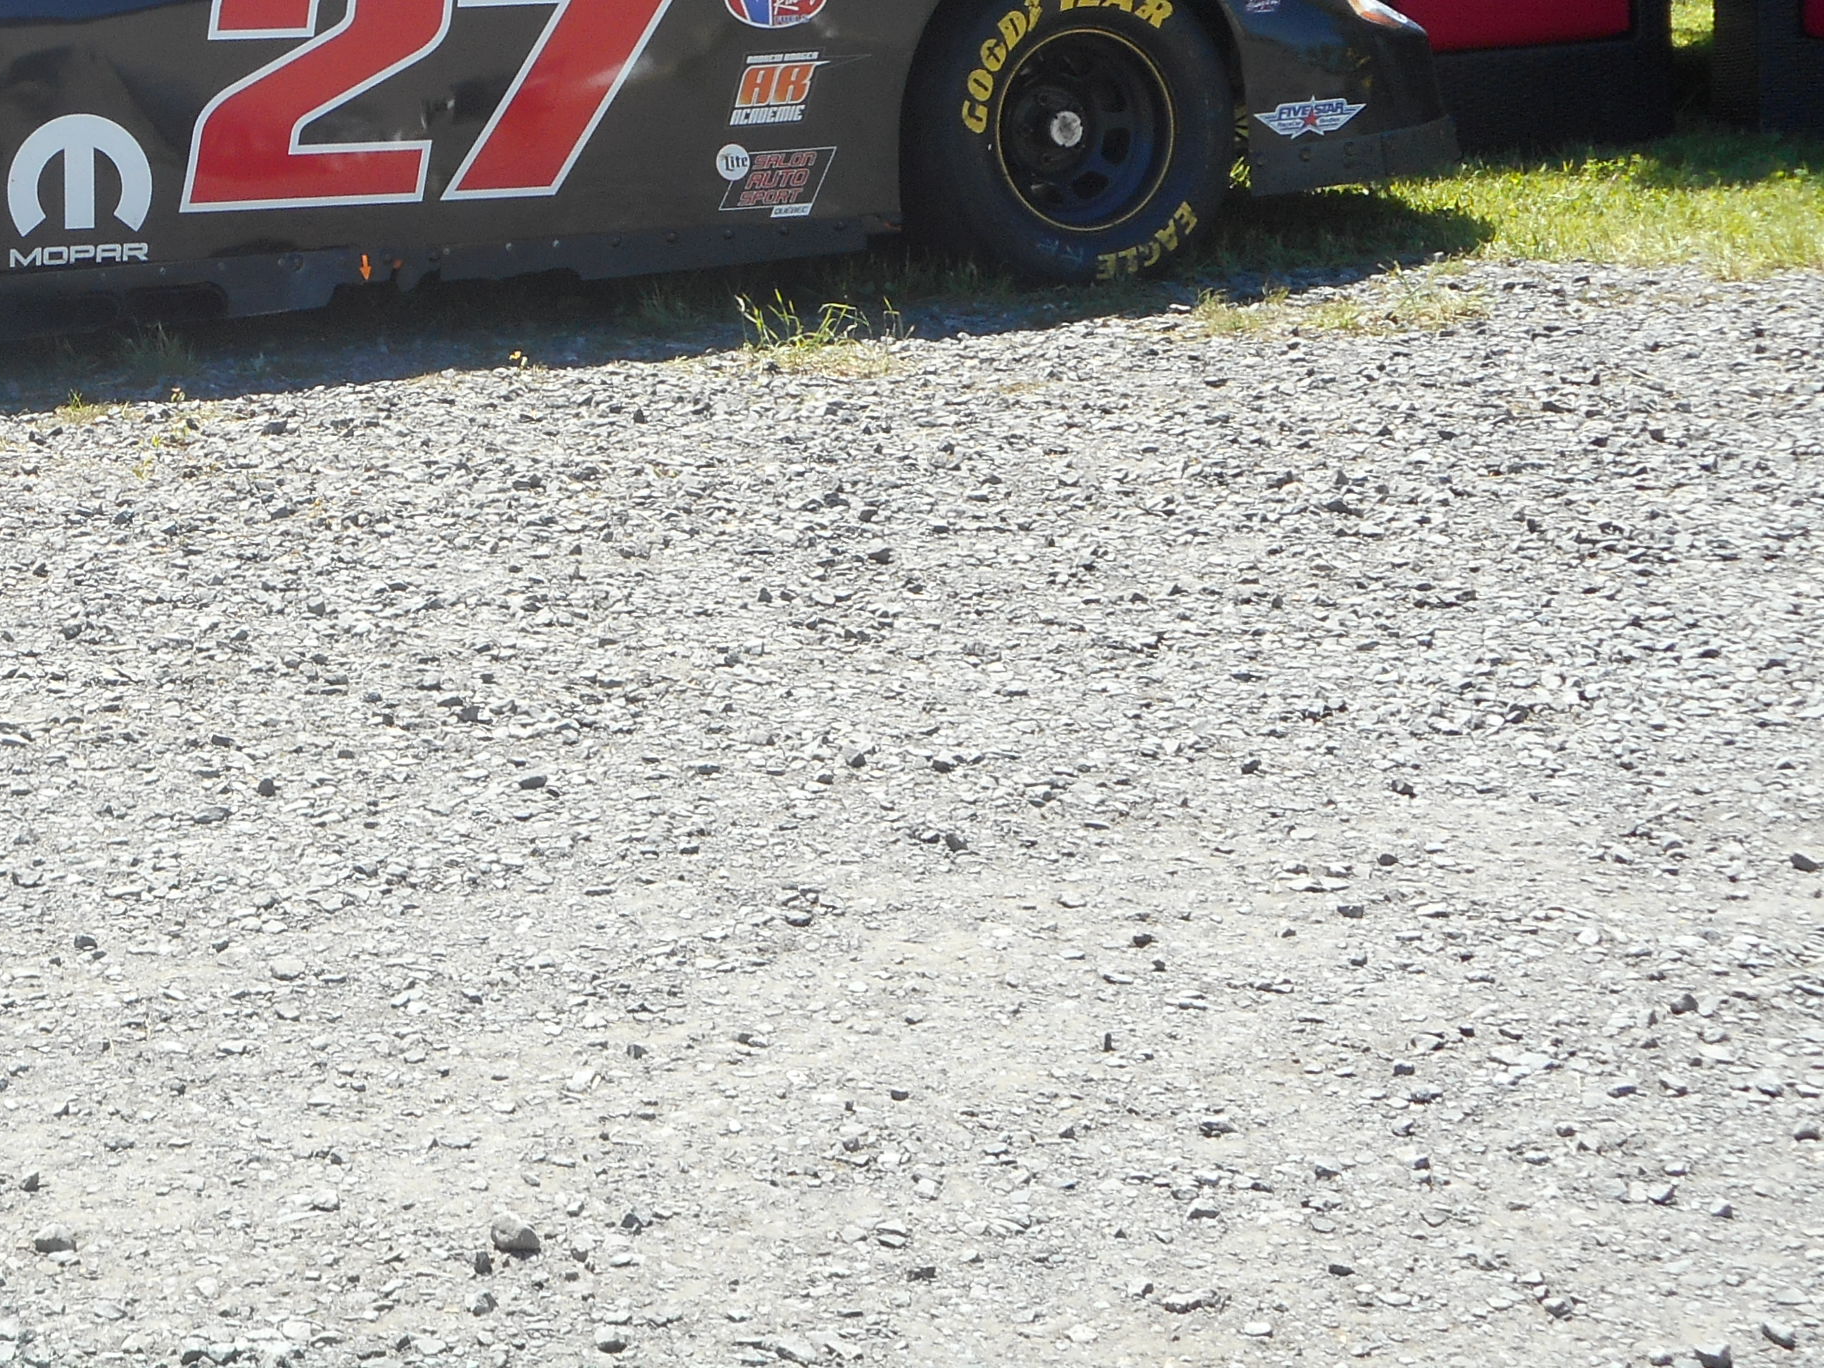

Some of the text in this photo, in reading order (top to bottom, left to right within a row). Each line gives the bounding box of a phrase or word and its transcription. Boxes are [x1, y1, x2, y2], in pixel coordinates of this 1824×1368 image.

[1279, 102, 1344, 120] FIVE STAR
[724, 153, 748, 172] Lite
[752, 151, 817, 170] SALON
[745, 168, 809, 190] AUTO
[737, 188, 804, 207] SPORT
[9, 242, 149, 268] MOPAR
